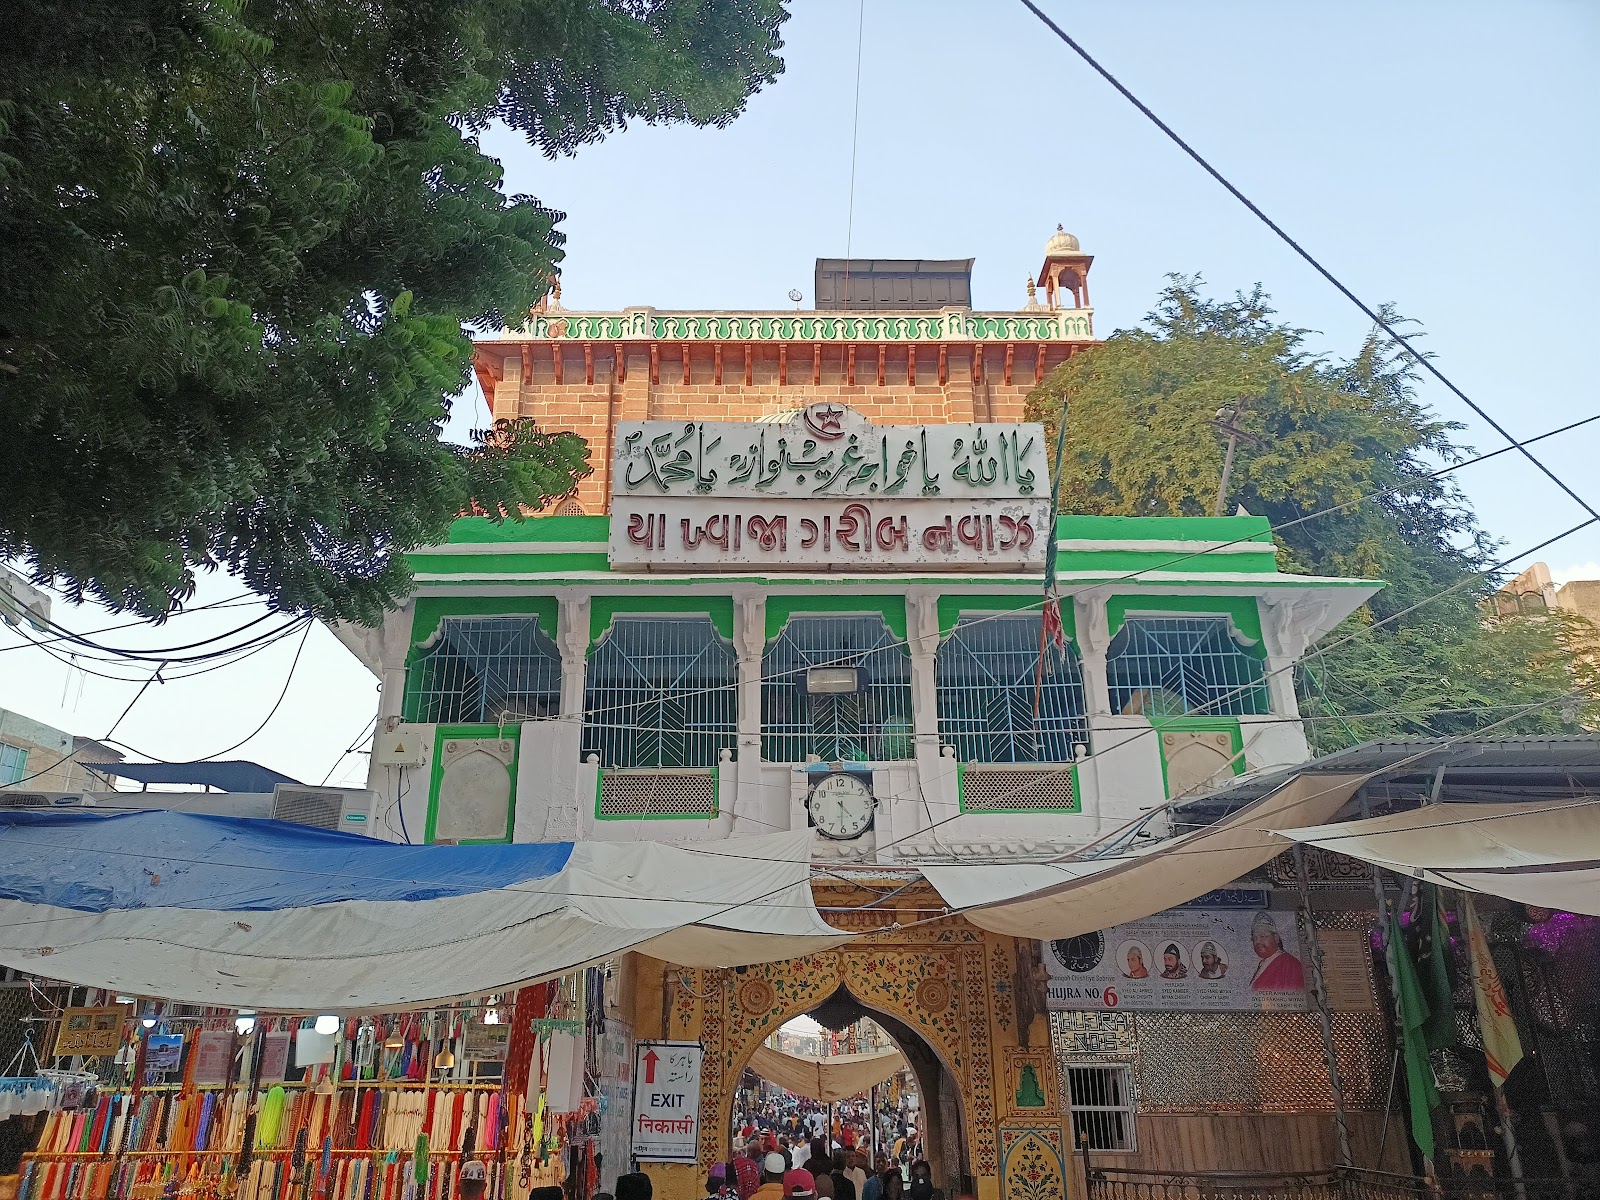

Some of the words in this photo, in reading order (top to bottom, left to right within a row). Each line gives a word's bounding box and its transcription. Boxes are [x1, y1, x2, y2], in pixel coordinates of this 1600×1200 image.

[627, 513, 667, 551] યા
[800, 503, 909, 552] ગરીબ
[827, 781, 833, 790] 11
[835, 778, 845, 787] 12
[818, 790, 827, 799] 10
[857, 788, 866, 797] 2
[814, 802, 821, 811] 9
[863, 800, 870, 810] 3
[819, 815, 826, 824] 8
[860, 814, 866, 822] 4
[828, 823, 835, 831] 7
[840, 825, 847, 834] 6
[852, 822, 859, 830] 5
[1047, 987, 1082, 1001] HUJRA
[1084, 987, 1102, 999] NO.
[1103, 986, 1118, 1008] 6
[651, 1093, 685, 1108] EXIT
[637, 1113, 695, 1135] निकासी
